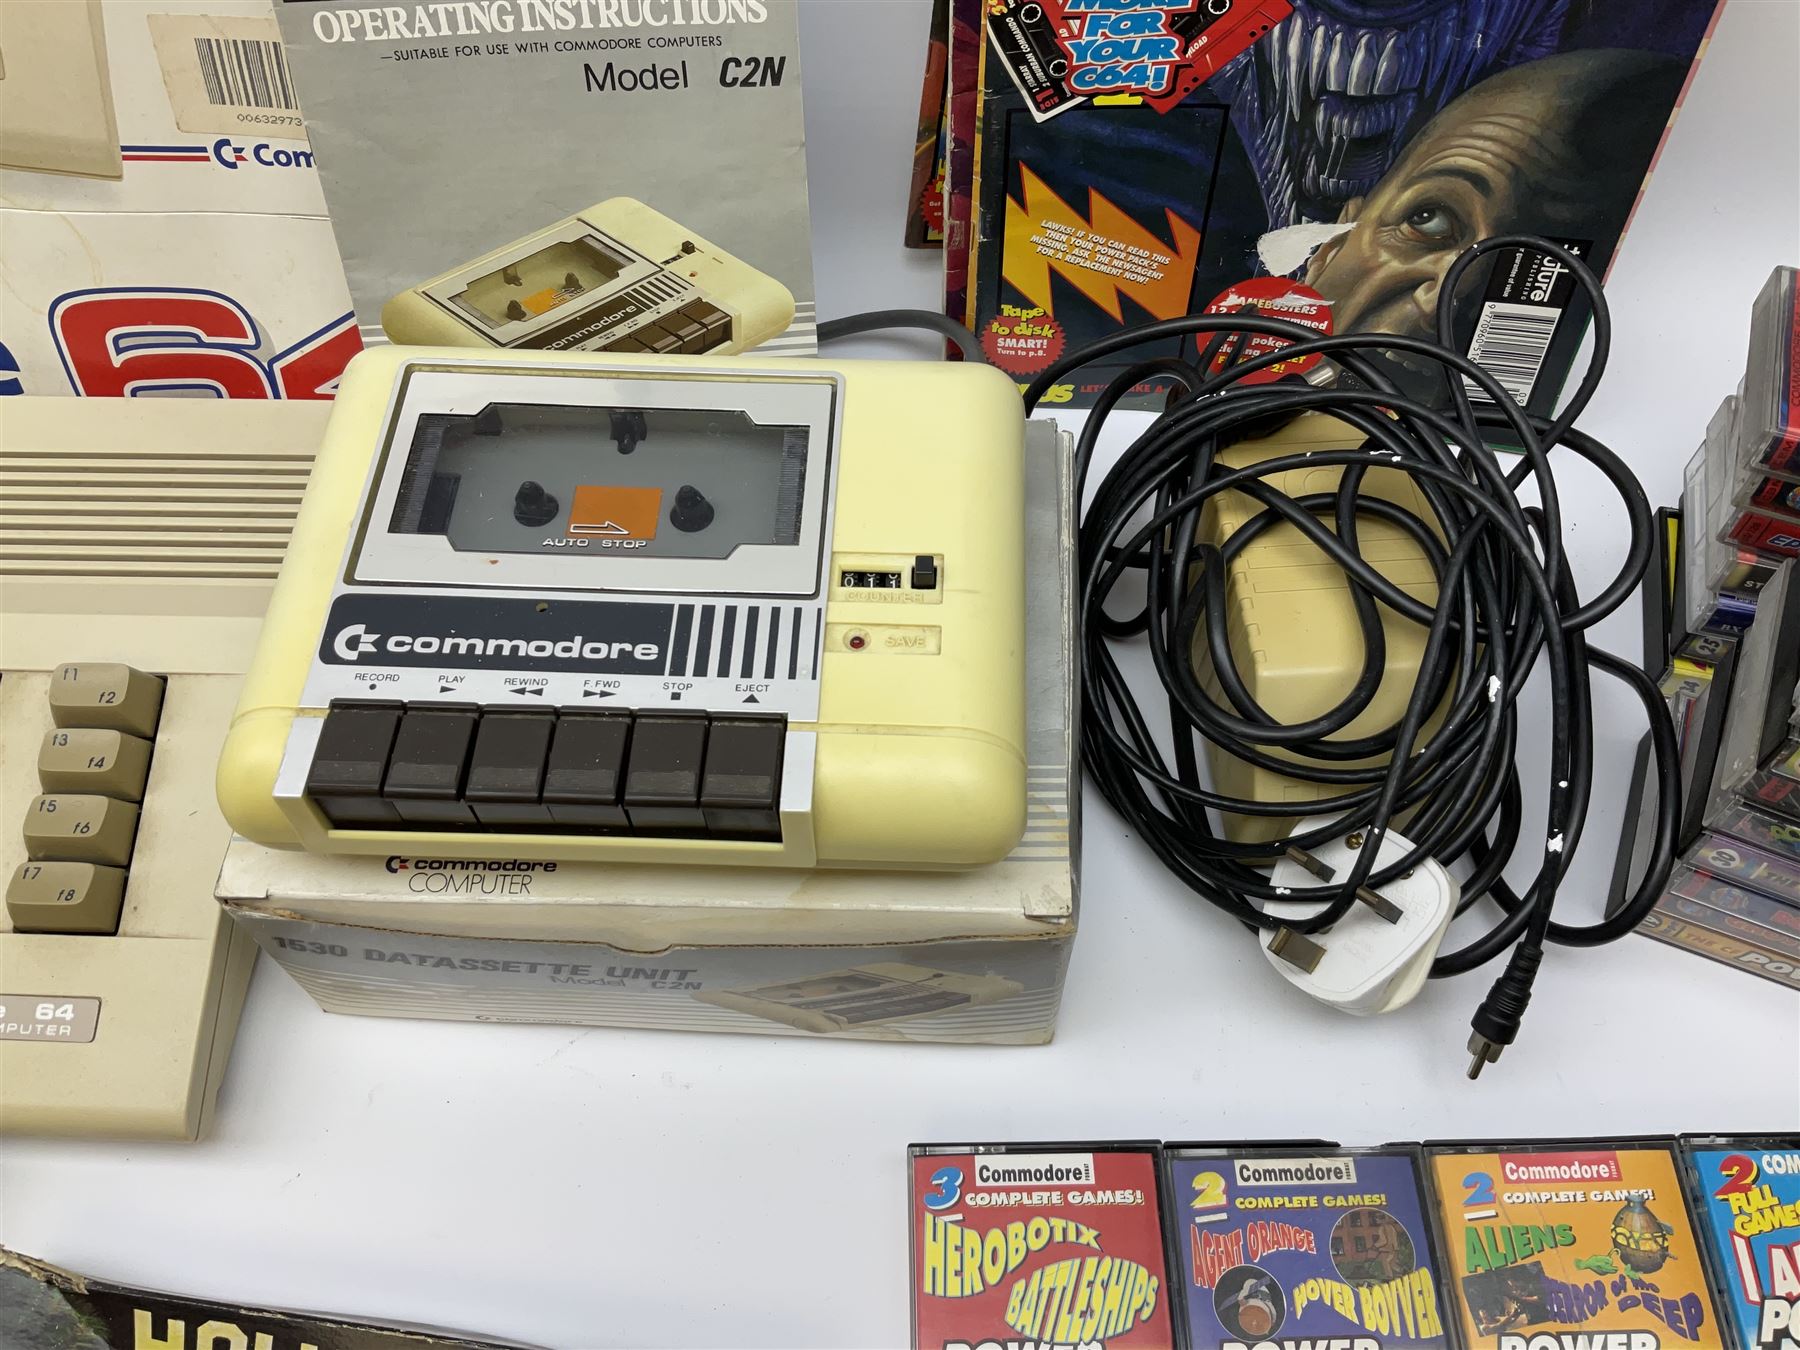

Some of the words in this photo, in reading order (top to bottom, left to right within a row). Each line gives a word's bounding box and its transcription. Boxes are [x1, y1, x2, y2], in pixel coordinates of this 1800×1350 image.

[312, 0, 515, 43] OPERATING
[516, 0, 768, 32] INSTRUCTIONS
[1083, 10, 1167, 38] FOR
[1006, 17, 1030, 53] COMMANDO
[455, 45, 481, 57] FOR
[486, 44, 509, 55] USE
[514, 42, 549, 54] WITH
[554, 38, 642, 52] COMMODORE
[647, 35, 722, 49] COMPUTERS
[1063, 37, 1181, 65] YOUR
[583, 60, 689, 92] Model
[719, 56, 787, 88] C2N
[236, 113, 302, 127] 00632973
[1040, 219, 1075, 235] LAWKS!
[1075, 230, 1086, 239] IF
[1087, 233, 1106, 245] YOU
[1108, 239, 1127, 250] CAN
[1126, 244, 1150, 258] READ
[1151, 253, 1171, 265] THIS
[1044, 229, 1068, 242] THEN
[1070, 236, 1094, 251] YOUR
[1095, 244, 1126, 260] POWER
[1128, 254, 1157, 270] PACK'S
[1036, 246, 1055, 257] FOR
[1065, 254, 1122, 278] REPLACEMENT
[1122, 271, 1150, 285] NOW!
[1071, 248, 1090, 259] ASK
[1095, 253, 1112, 265] THE
[1111, 256, 1164, 281] NEWSAGENT
[1521, 254, 1542, 300] PUBLISHING
[1530, 256, 1569, 303] uture
[1000, 304, 1046, 321] Tape
[991, 322, 1011, 336] to
[1013, 322, 1056, 339] disk
[996, 337, 1048, 349] SMART!
[997, 348, 1015, 356] Turn
[541, 537, 589, 548] AUTO
[601, 538, 647, 549] STOP
[845, 591, 925, 602] COUNTER
[386, 634, 660, 661] commodore
[885, 635, 927, 648] SAVE
[63, 667, 79, 681] f1
[354, 671, 401, 682] RECORD
[438, 674, 466, 685] PLAY
[503, 676, 550, 688] REWIND
[583, 679, 622, 690] F.FWD
[662, 681, 694, 691] STOP
[735, 683, 770, 693] EJECT
[98, 691, 116, 704] f2
[52, 733, 69, 746] f3
[87, 756, 105, 768] f4
[39, 799, 57, 813] f5
[72, 822, 90, 834] f6
[22, 866, 42, 880] f7
[414, 858, 558, 873] commodore
[408, 871, 533, 895] COMPUTER
[57, 889, 76, 901] f8
[271, 935, 348, 958] 1530
[363, 948, 593, 978] DATASSETTE
[606, 965, 698, 981] UNIT
[549, 973, 627, 988] Model
[651, 980, 704, 991] C2N
[35, 1003, 75, 1021] 64
[1190, 1171, 1229, 1210] 2
[1239, 1163, 1344, 1183] Commodore
[1462, 1171, 1497, 1207] 2
[1505, 1161, 1610, 1181] Commodore
[1714, 1154, 1760, 1201] 2
[923, 1166, 965, 1211] 3
[978, 1164, 1083, 1183] Commodore
[1502, 1189, 1587, 1205] COMPLETE
[965, 1191, 1064, 1208] COMPLETE
[1067, 1189, 1145, 1206] GAMES!
[1234, 1195, 1319, 1210] COMPLETE
[1323, 1193, 1388, 1208] GAMES!
[1727, 1184, 1780, 1215] FULL
[923, 1210, 1104, 1298] HEROBOTIX
[1190, 1223, 1244, 1290] AGENT
[1246, 1221, 1317, 1263] ORANGE
[1464, 1223, 1577, 1274] ALIENS
[1728, 1229, 1761, 1306] I
[1004, 1255, 1159, 1345] BATTLESHIPS
[1292, 1277, 1360, 1326] HOVER
[1617, 1291, 1704, 1342] DEEP
